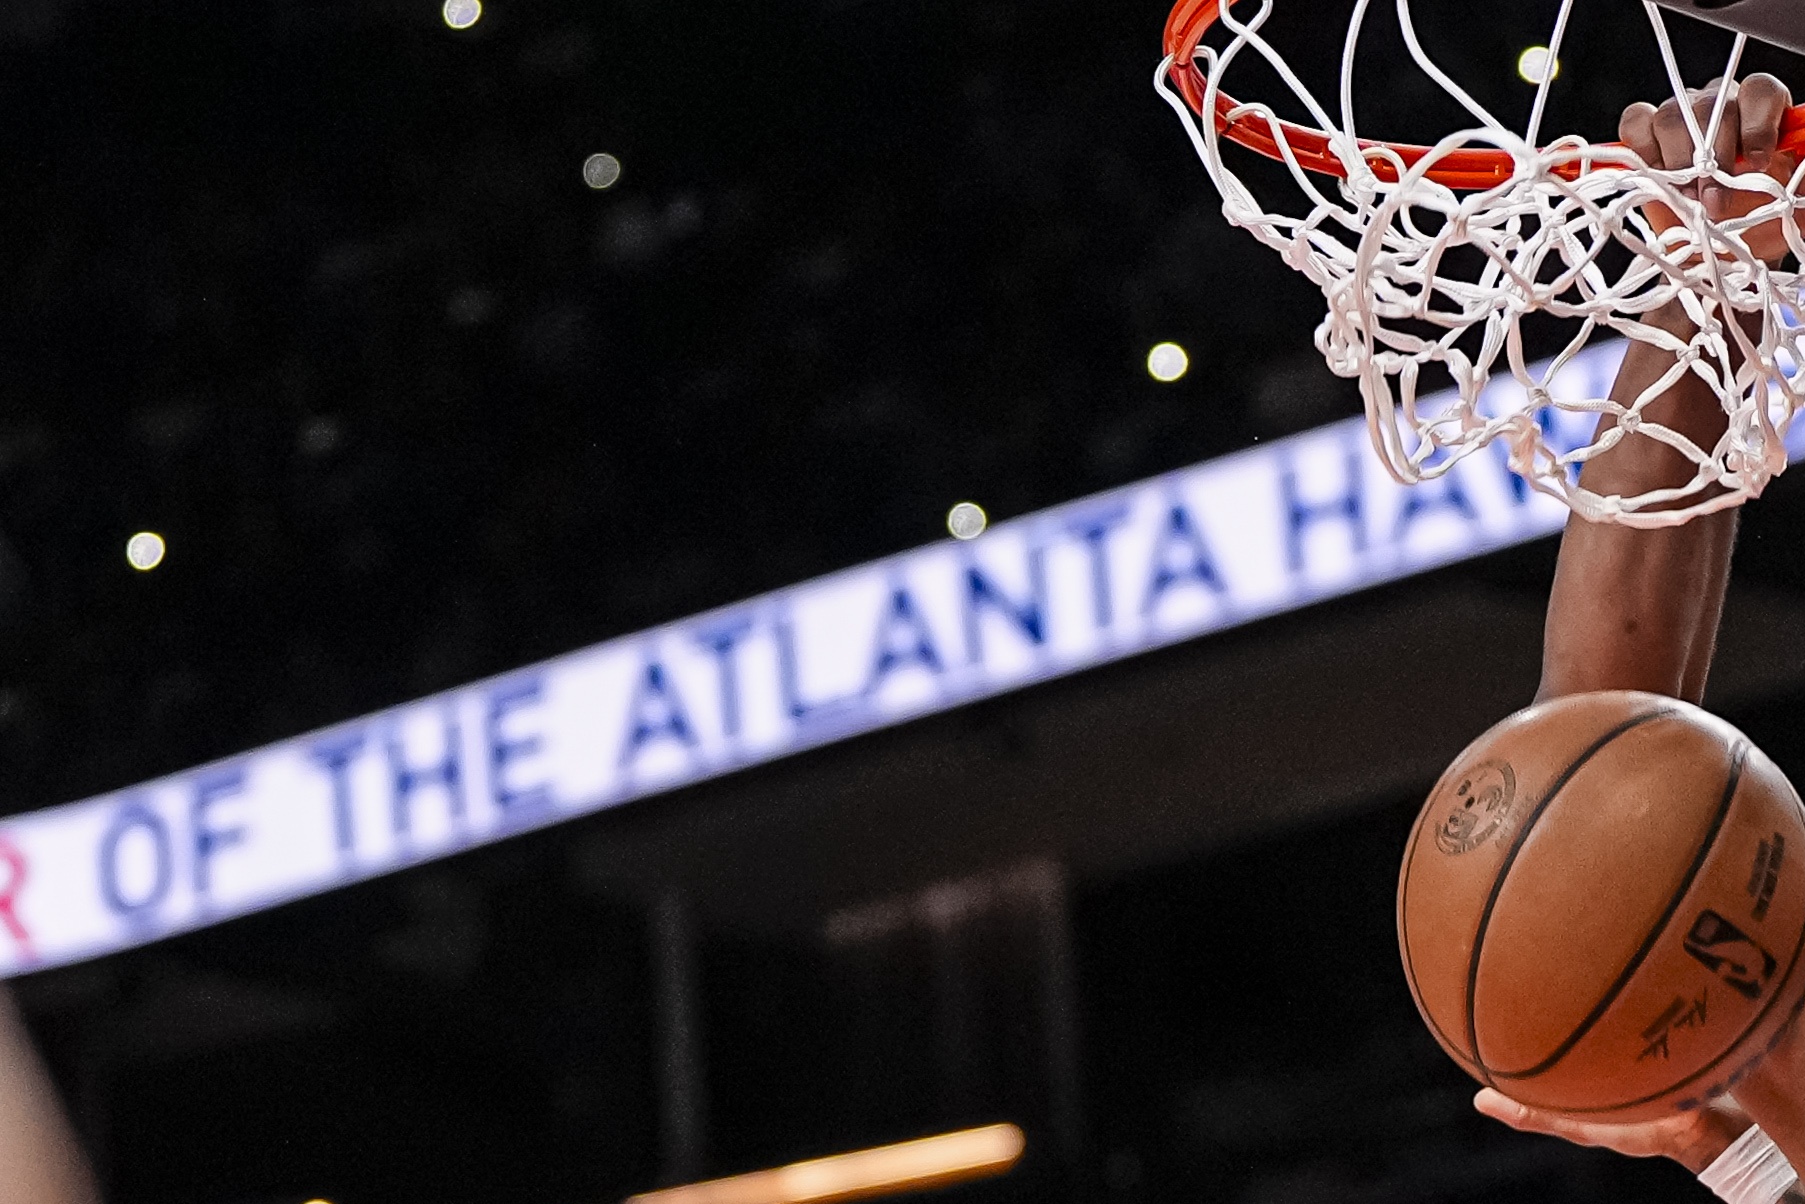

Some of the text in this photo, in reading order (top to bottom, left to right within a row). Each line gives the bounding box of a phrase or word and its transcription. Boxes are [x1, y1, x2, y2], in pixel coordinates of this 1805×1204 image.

[98, 768, 256, 930] OF
[308, 678, 552, 866] THE
[616, 492, 1226, 780] ATLANTA
